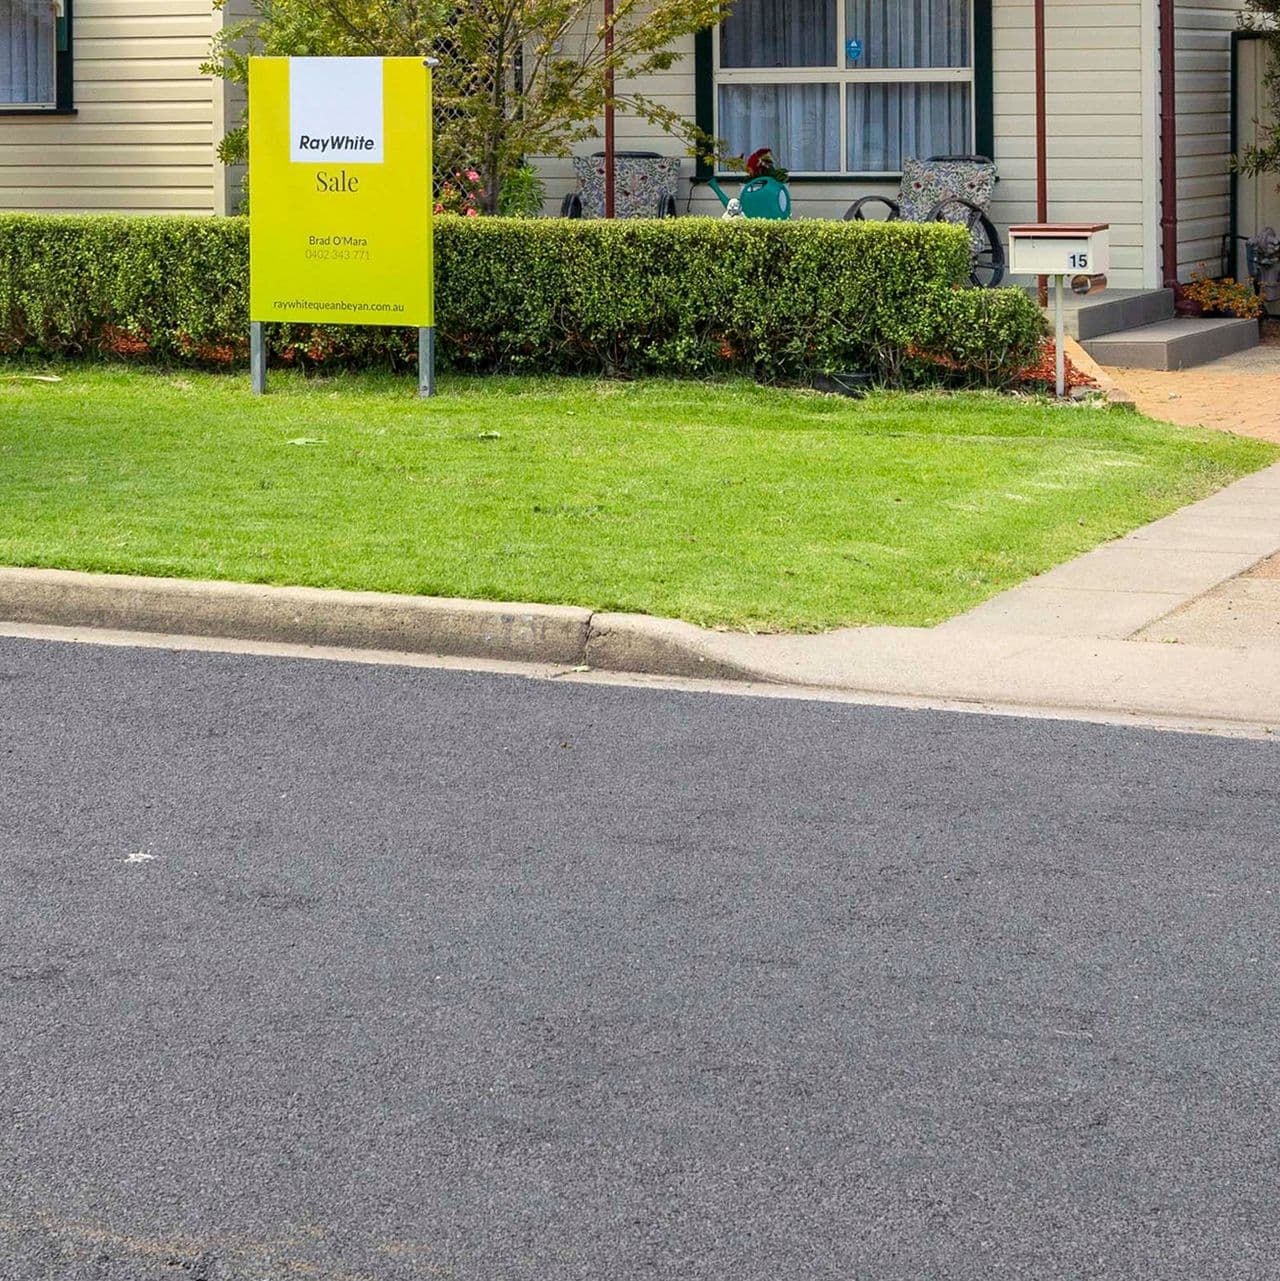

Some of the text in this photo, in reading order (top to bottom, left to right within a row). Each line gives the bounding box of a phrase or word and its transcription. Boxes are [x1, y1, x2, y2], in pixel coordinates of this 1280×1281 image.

[316, 170, 359, 193] Sale
[309, 235, 368, 246] Brad O'Mara
[1069, 254, 1088, 268] 15
[273, 300, 405, 312] raywhitequeanbeyan.com.au
